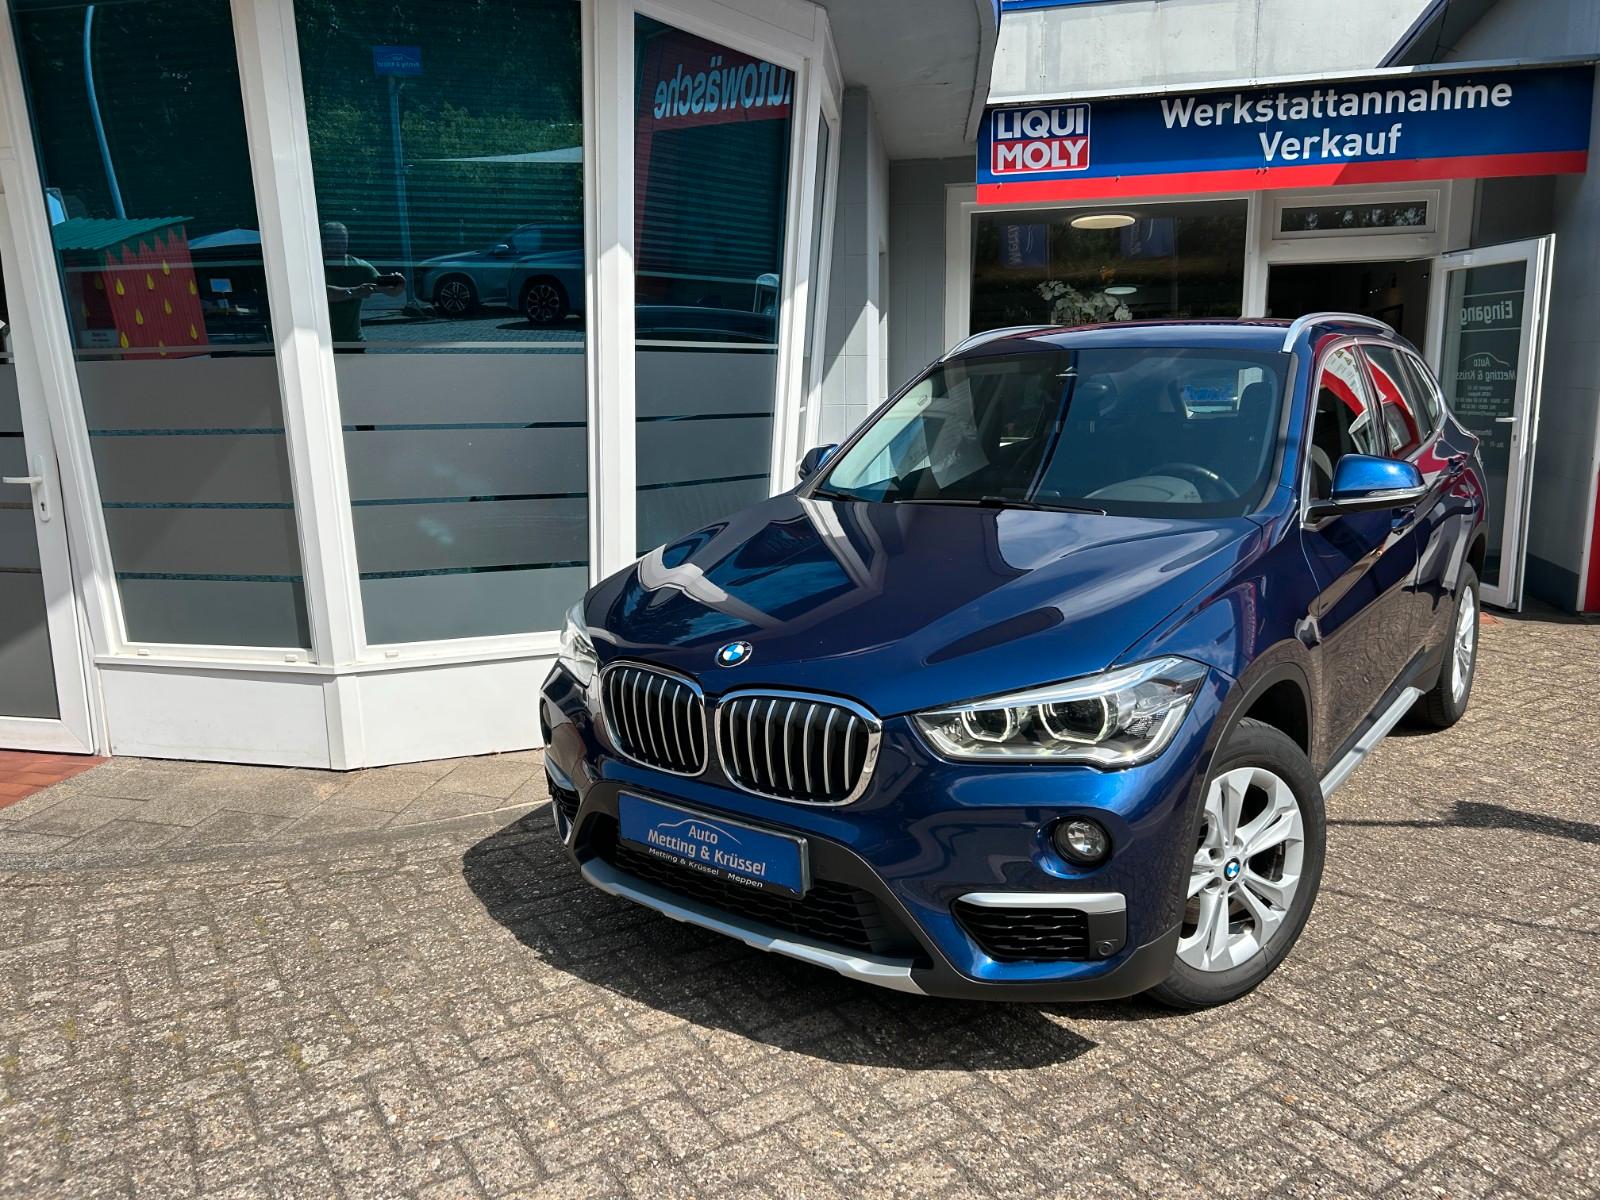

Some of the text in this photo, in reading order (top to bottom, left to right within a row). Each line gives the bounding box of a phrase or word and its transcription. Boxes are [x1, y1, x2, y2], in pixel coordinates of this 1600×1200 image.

[1160, 79, 1513, 128] Werkstattannahme
[997, 107, 1085, 139] LIQUI
[1259, 123, 1402, 161] Verkauf
[996, 139, 1087, 171] MOLY
[647, 829, 766, 876] Metting & Krüssel
[688, 825, 718, 845] Auto
[648, 848, 678, 863] Metting
[688, 860, 719, 875] Krüssel
[727, 873, 763, 888] Meppen
